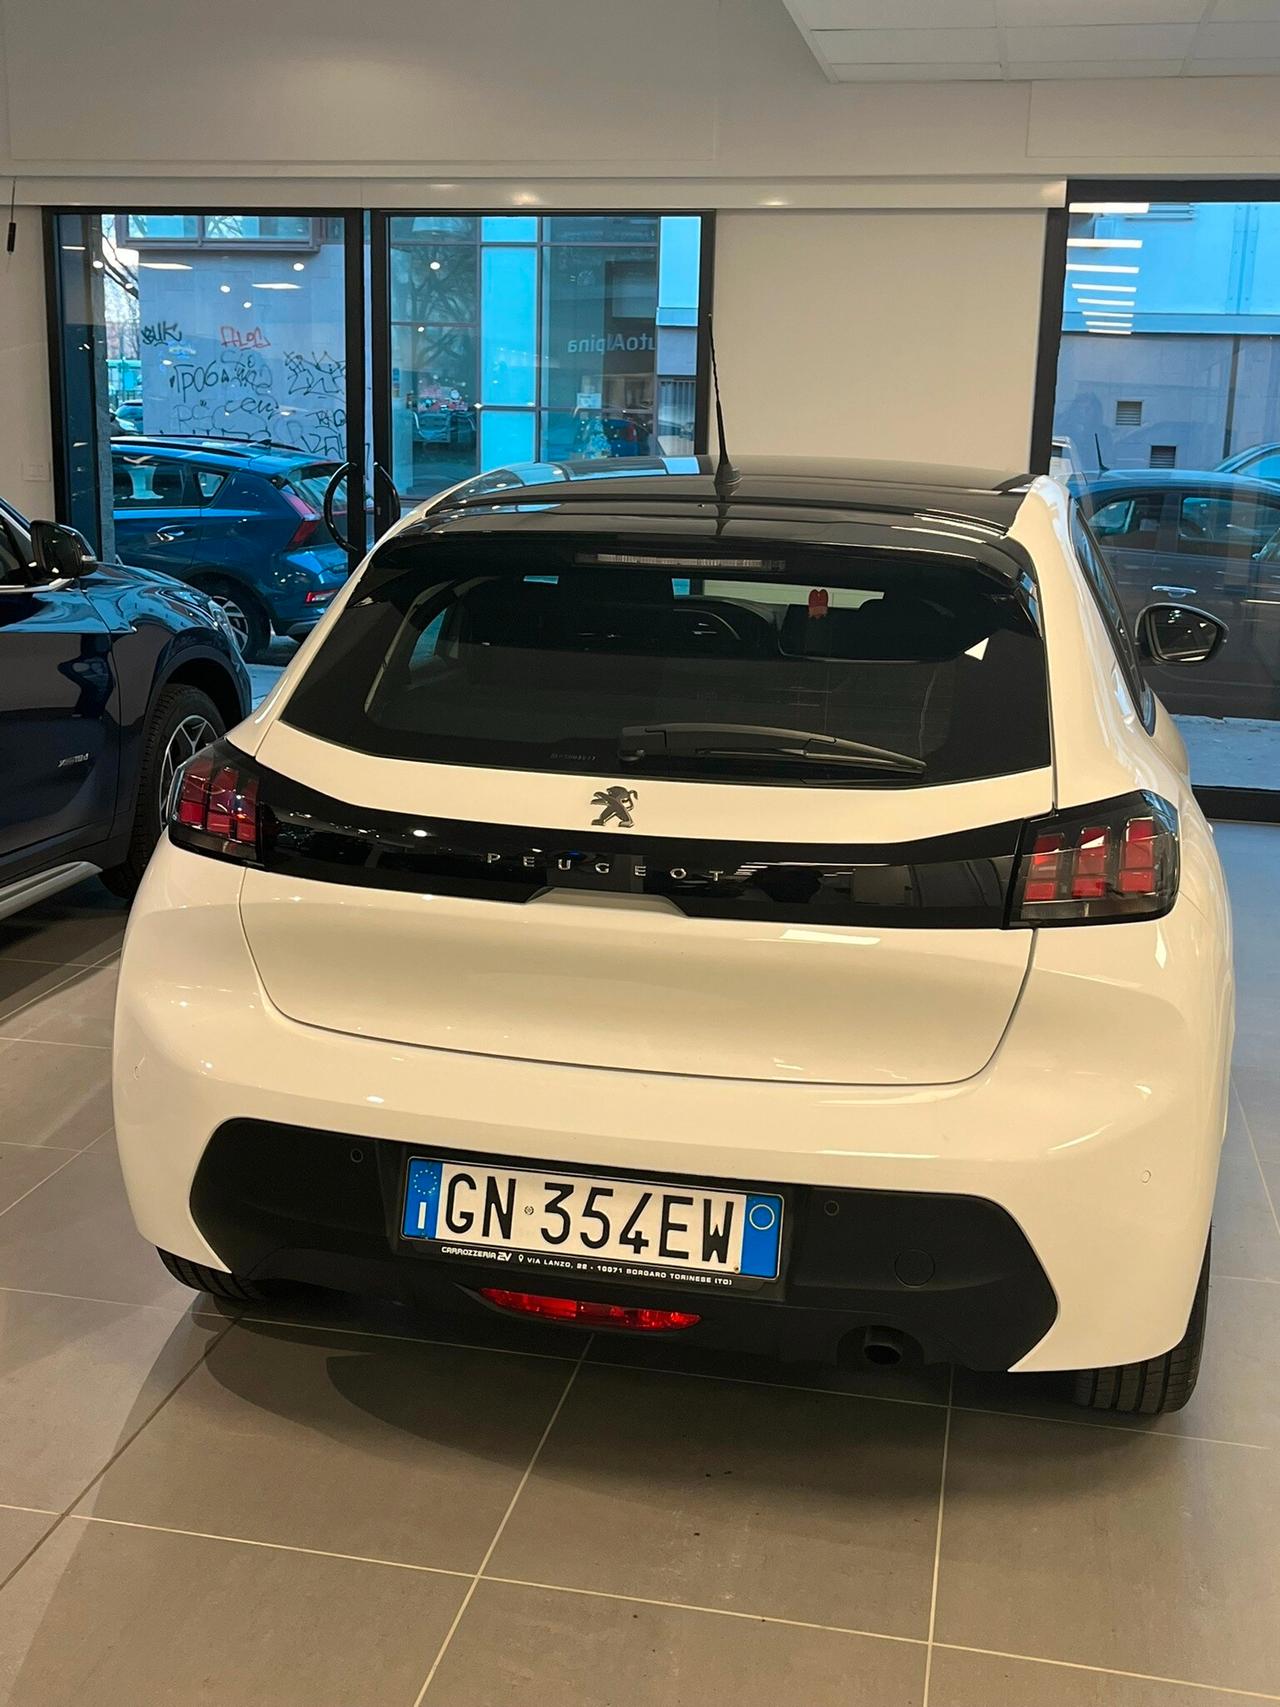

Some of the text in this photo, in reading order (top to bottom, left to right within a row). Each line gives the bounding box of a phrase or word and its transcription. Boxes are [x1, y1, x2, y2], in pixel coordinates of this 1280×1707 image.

[486, 852, 724, 882] PEUGEOT
[444, 1172, 735, 1264] GN 354EW
[441, 1246, 497, 1259] CARROZZERIA
[544, 1259, 573, 1269] LANZO,
[626, 1269, 667, 1278] BORGARO
[670, 1273, 712, 1283] TORINESE
